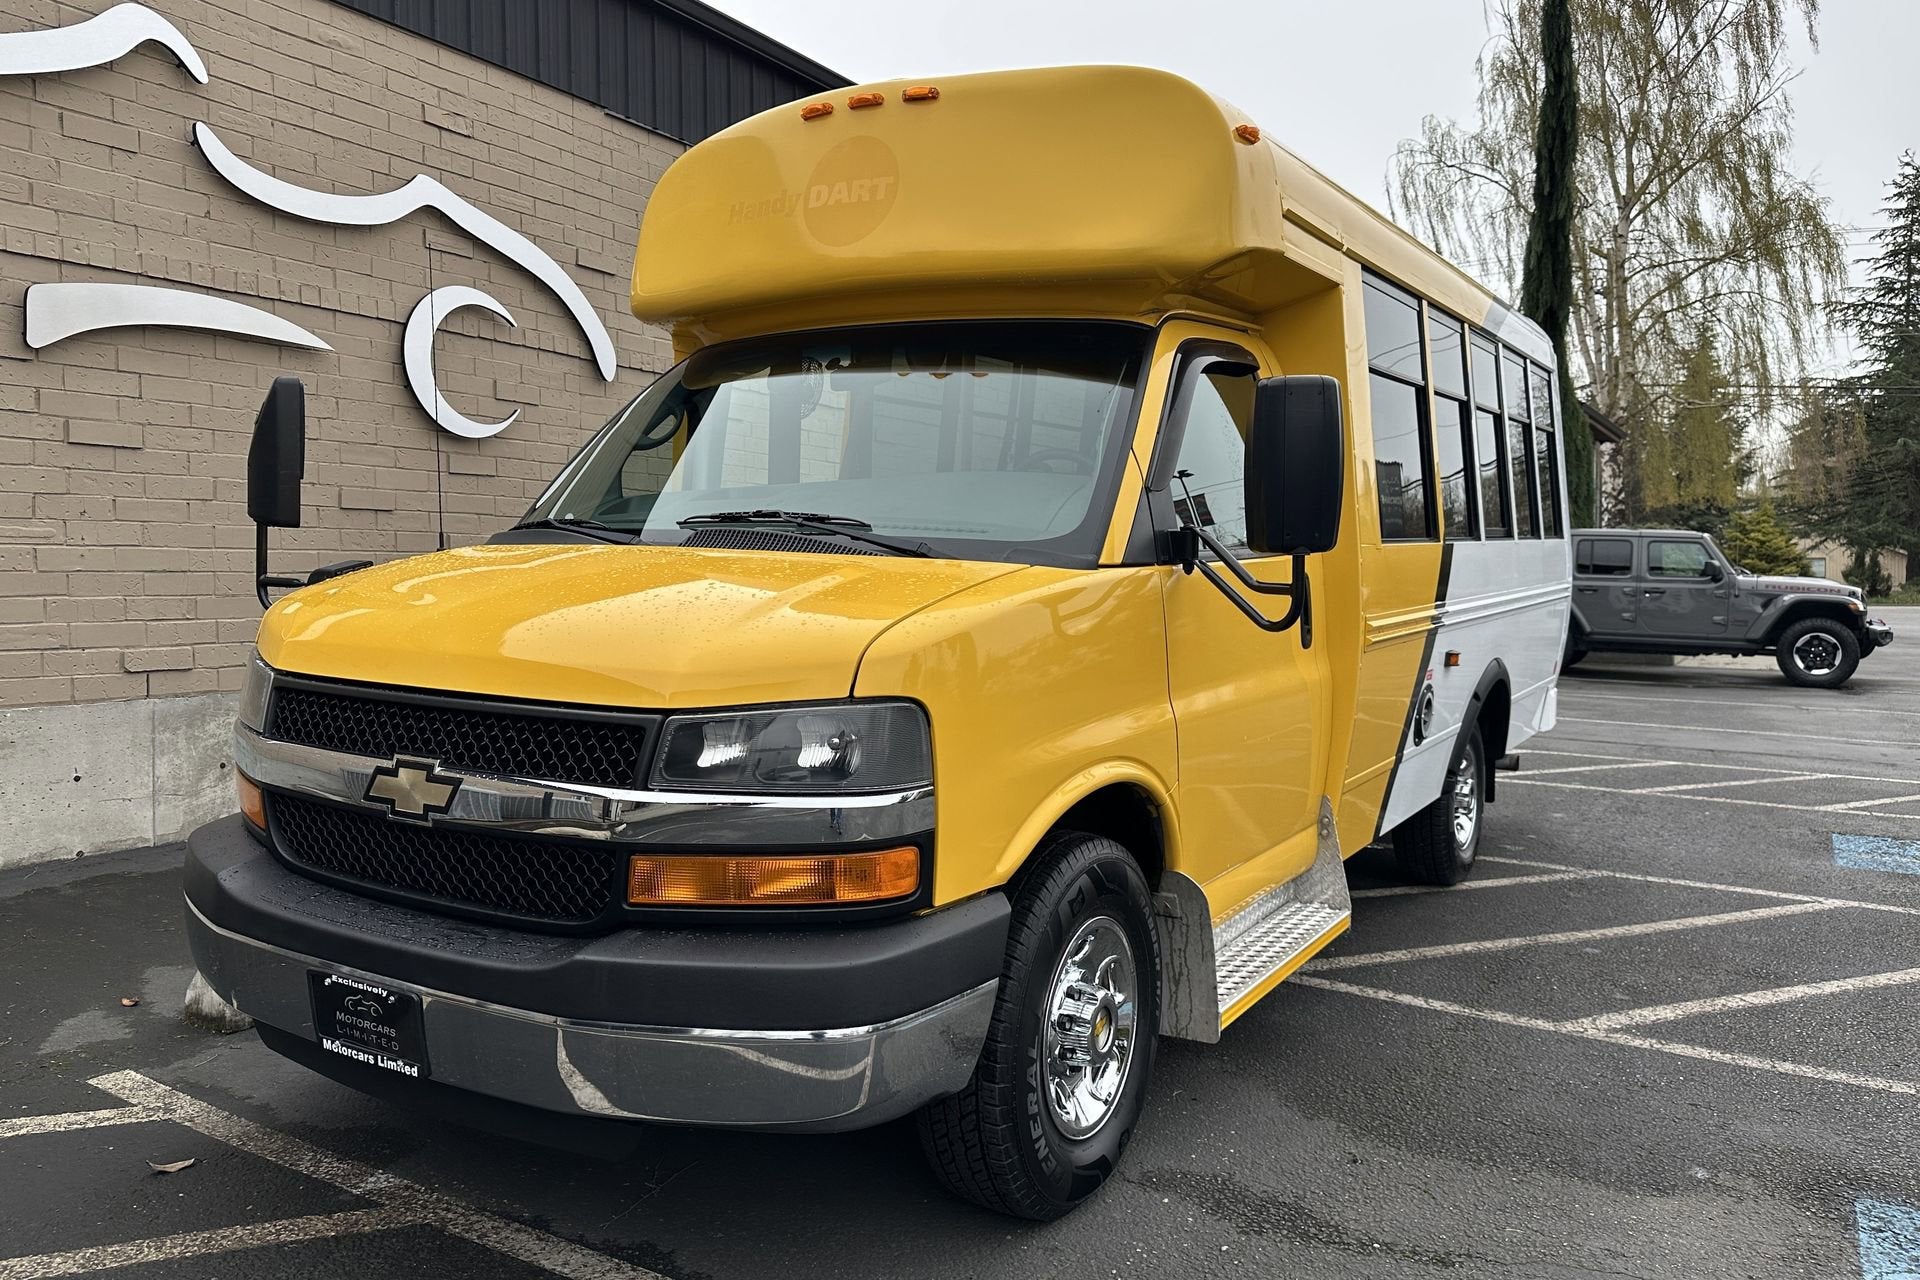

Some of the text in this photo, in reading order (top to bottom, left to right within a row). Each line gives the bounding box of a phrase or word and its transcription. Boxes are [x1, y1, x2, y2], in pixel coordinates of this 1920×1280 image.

[727, 176, 894, 226] Handy DART
[1764, 583, 1842, 594] RUBICON
[331, 974, 389, 998] Exclusively
[336, 1010, 397, 1038] MOTORCARS
[322, 1038, 419, 1078] Motorcars Limited
[1026, 1034, 1062, 1184] ENERAL
